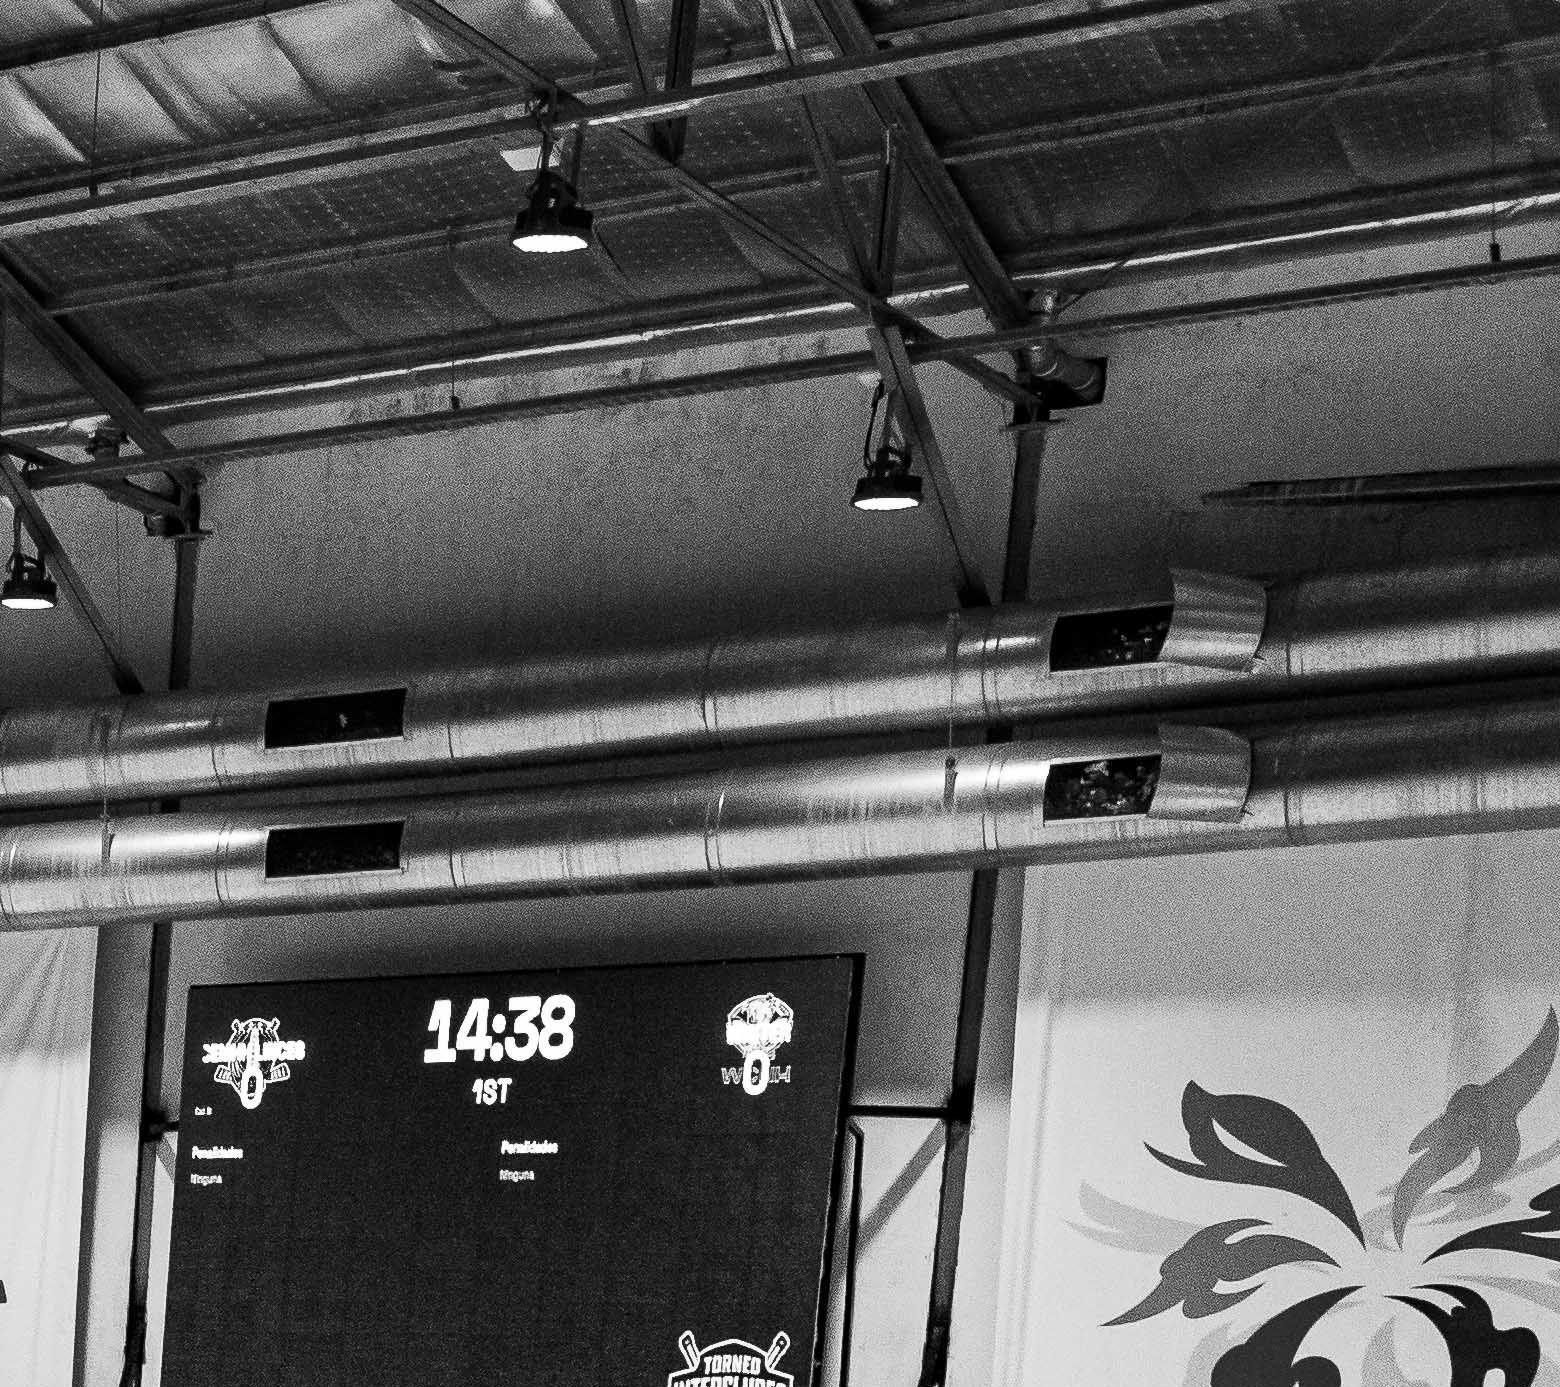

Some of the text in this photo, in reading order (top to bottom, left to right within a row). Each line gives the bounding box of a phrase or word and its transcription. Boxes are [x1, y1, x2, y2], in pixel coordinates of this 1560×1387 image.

[423, 993, 576, 1063] 14:38
[472, 1077, 513, 1105] 1ST
[703, 1354, 762, 1375] TORNEO
